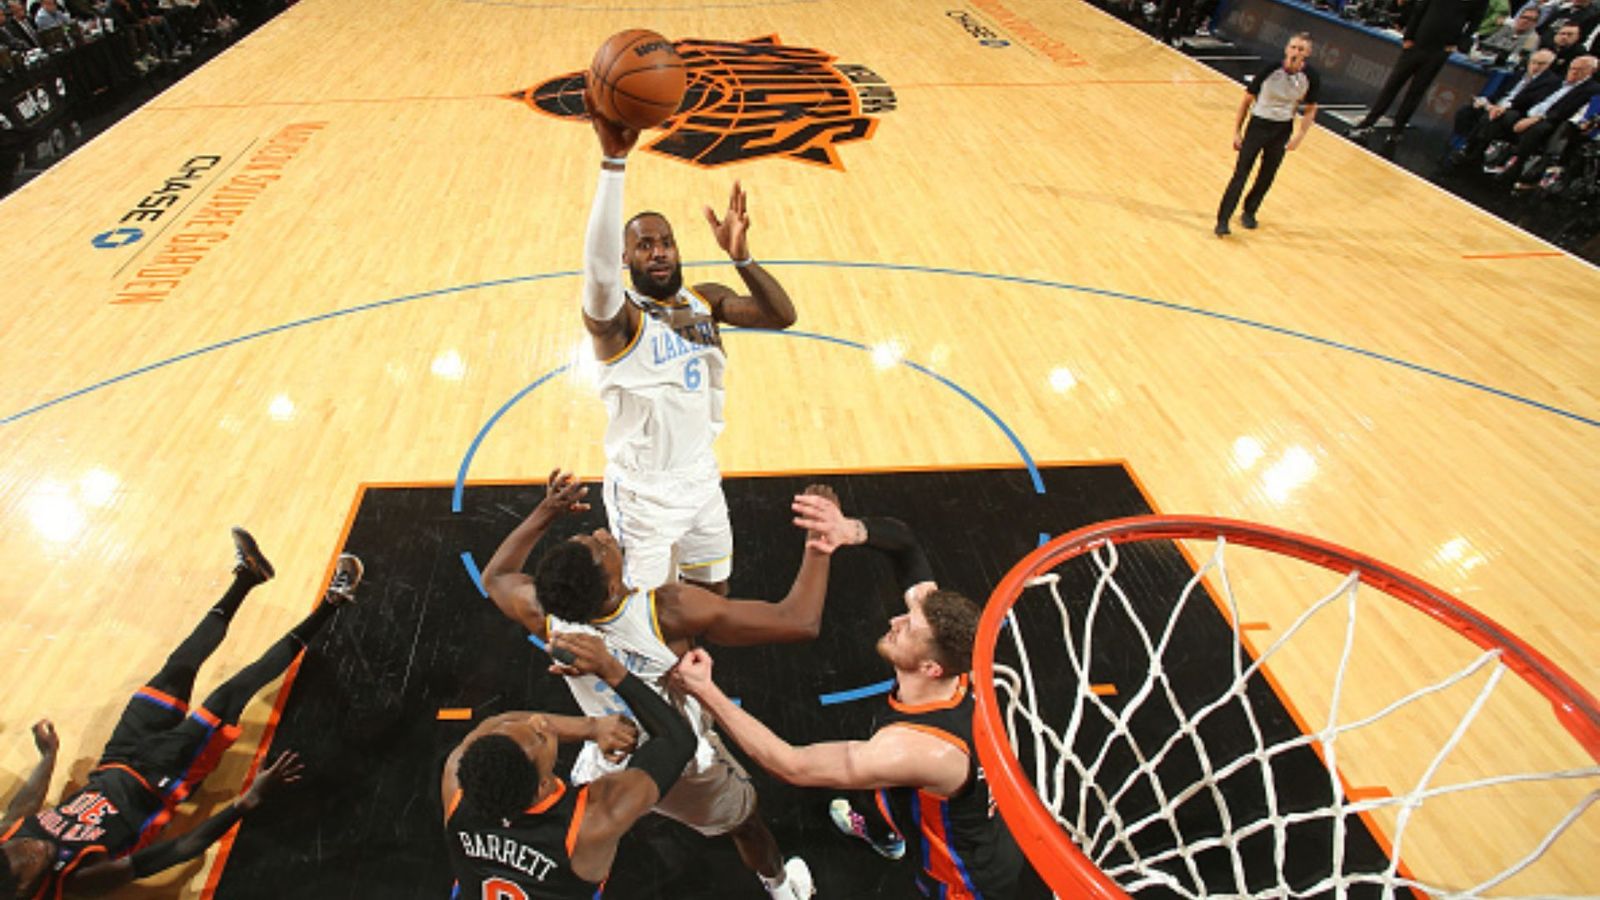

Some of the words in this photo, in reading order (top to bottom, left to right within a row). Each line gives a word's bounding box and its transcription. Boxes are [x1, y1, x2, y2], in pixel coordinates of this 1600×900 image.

[117, 155, 222, 224] CHASE
[107, 231, 230, 305] GARDEN
[684, 357, 702, 390] 6
[457, 831, 558, 882] BARRETT
